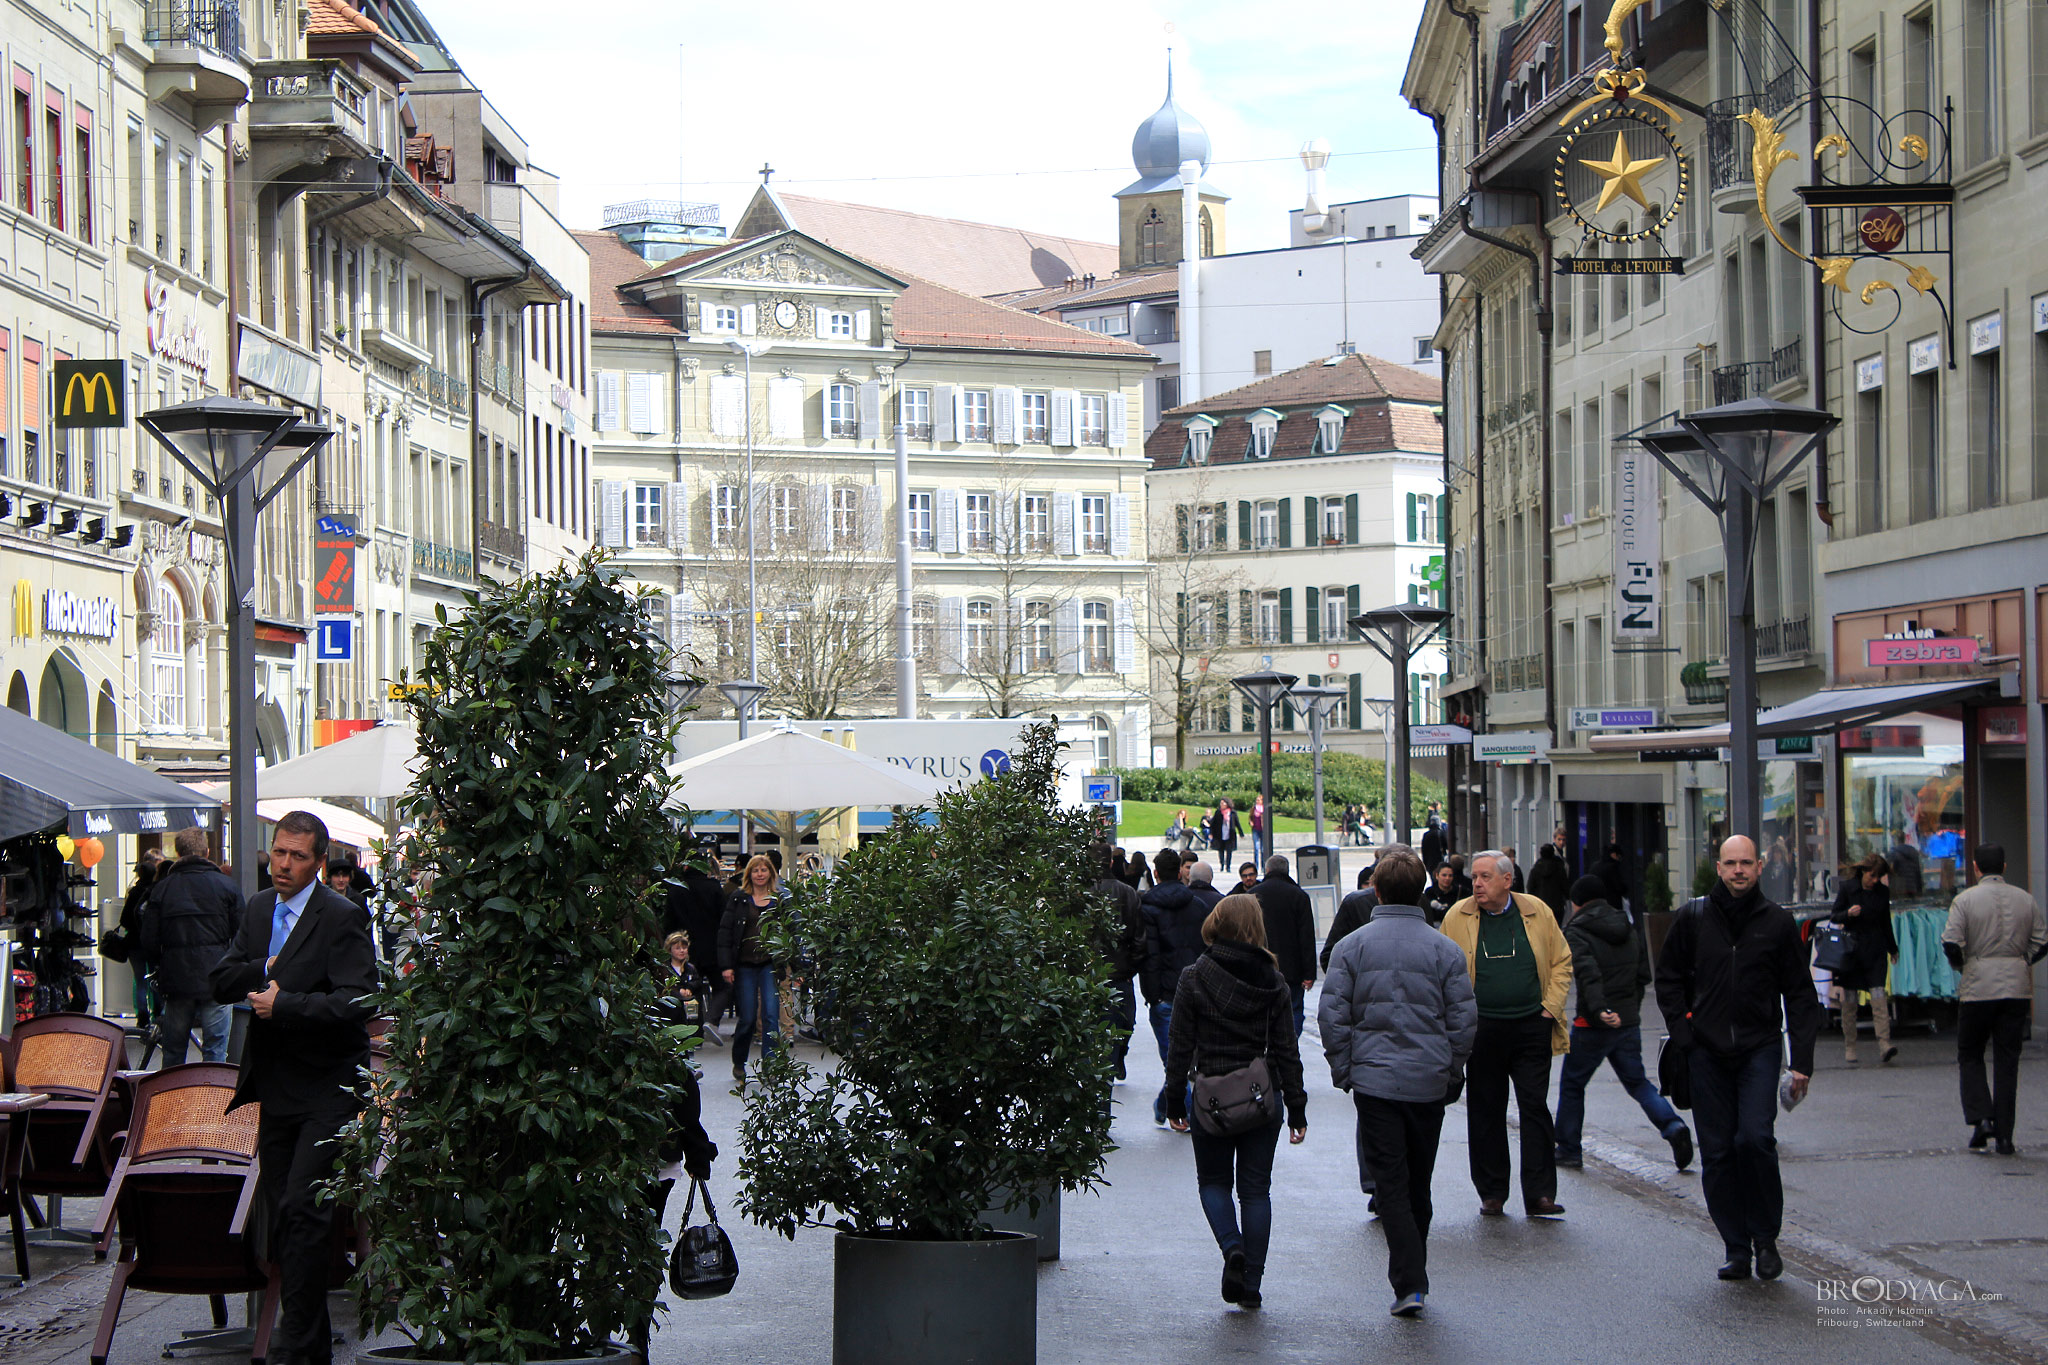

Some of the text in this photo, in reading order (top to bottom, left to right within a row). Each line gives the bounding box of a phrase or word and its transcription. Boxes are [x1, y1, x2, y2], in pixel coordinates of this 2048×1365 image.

[1572, 259, 1673, 274] HOTEL de L'ETOILE
[1621, 460, 1635, 551] BOUTIQUE
[46, 588, 119, 638] McDonald's
[324, 625, 343, 654] L
[1886, 643, 1962, 661] zebra
[1602, 713, 1650, 723] VALIANT
[1193, 745, 1254, 756] RISTORANTE
[1283, 743, 1329, 754] PIZZEA
[1481, 745, 1536, 753] BANQUEMIGROS
